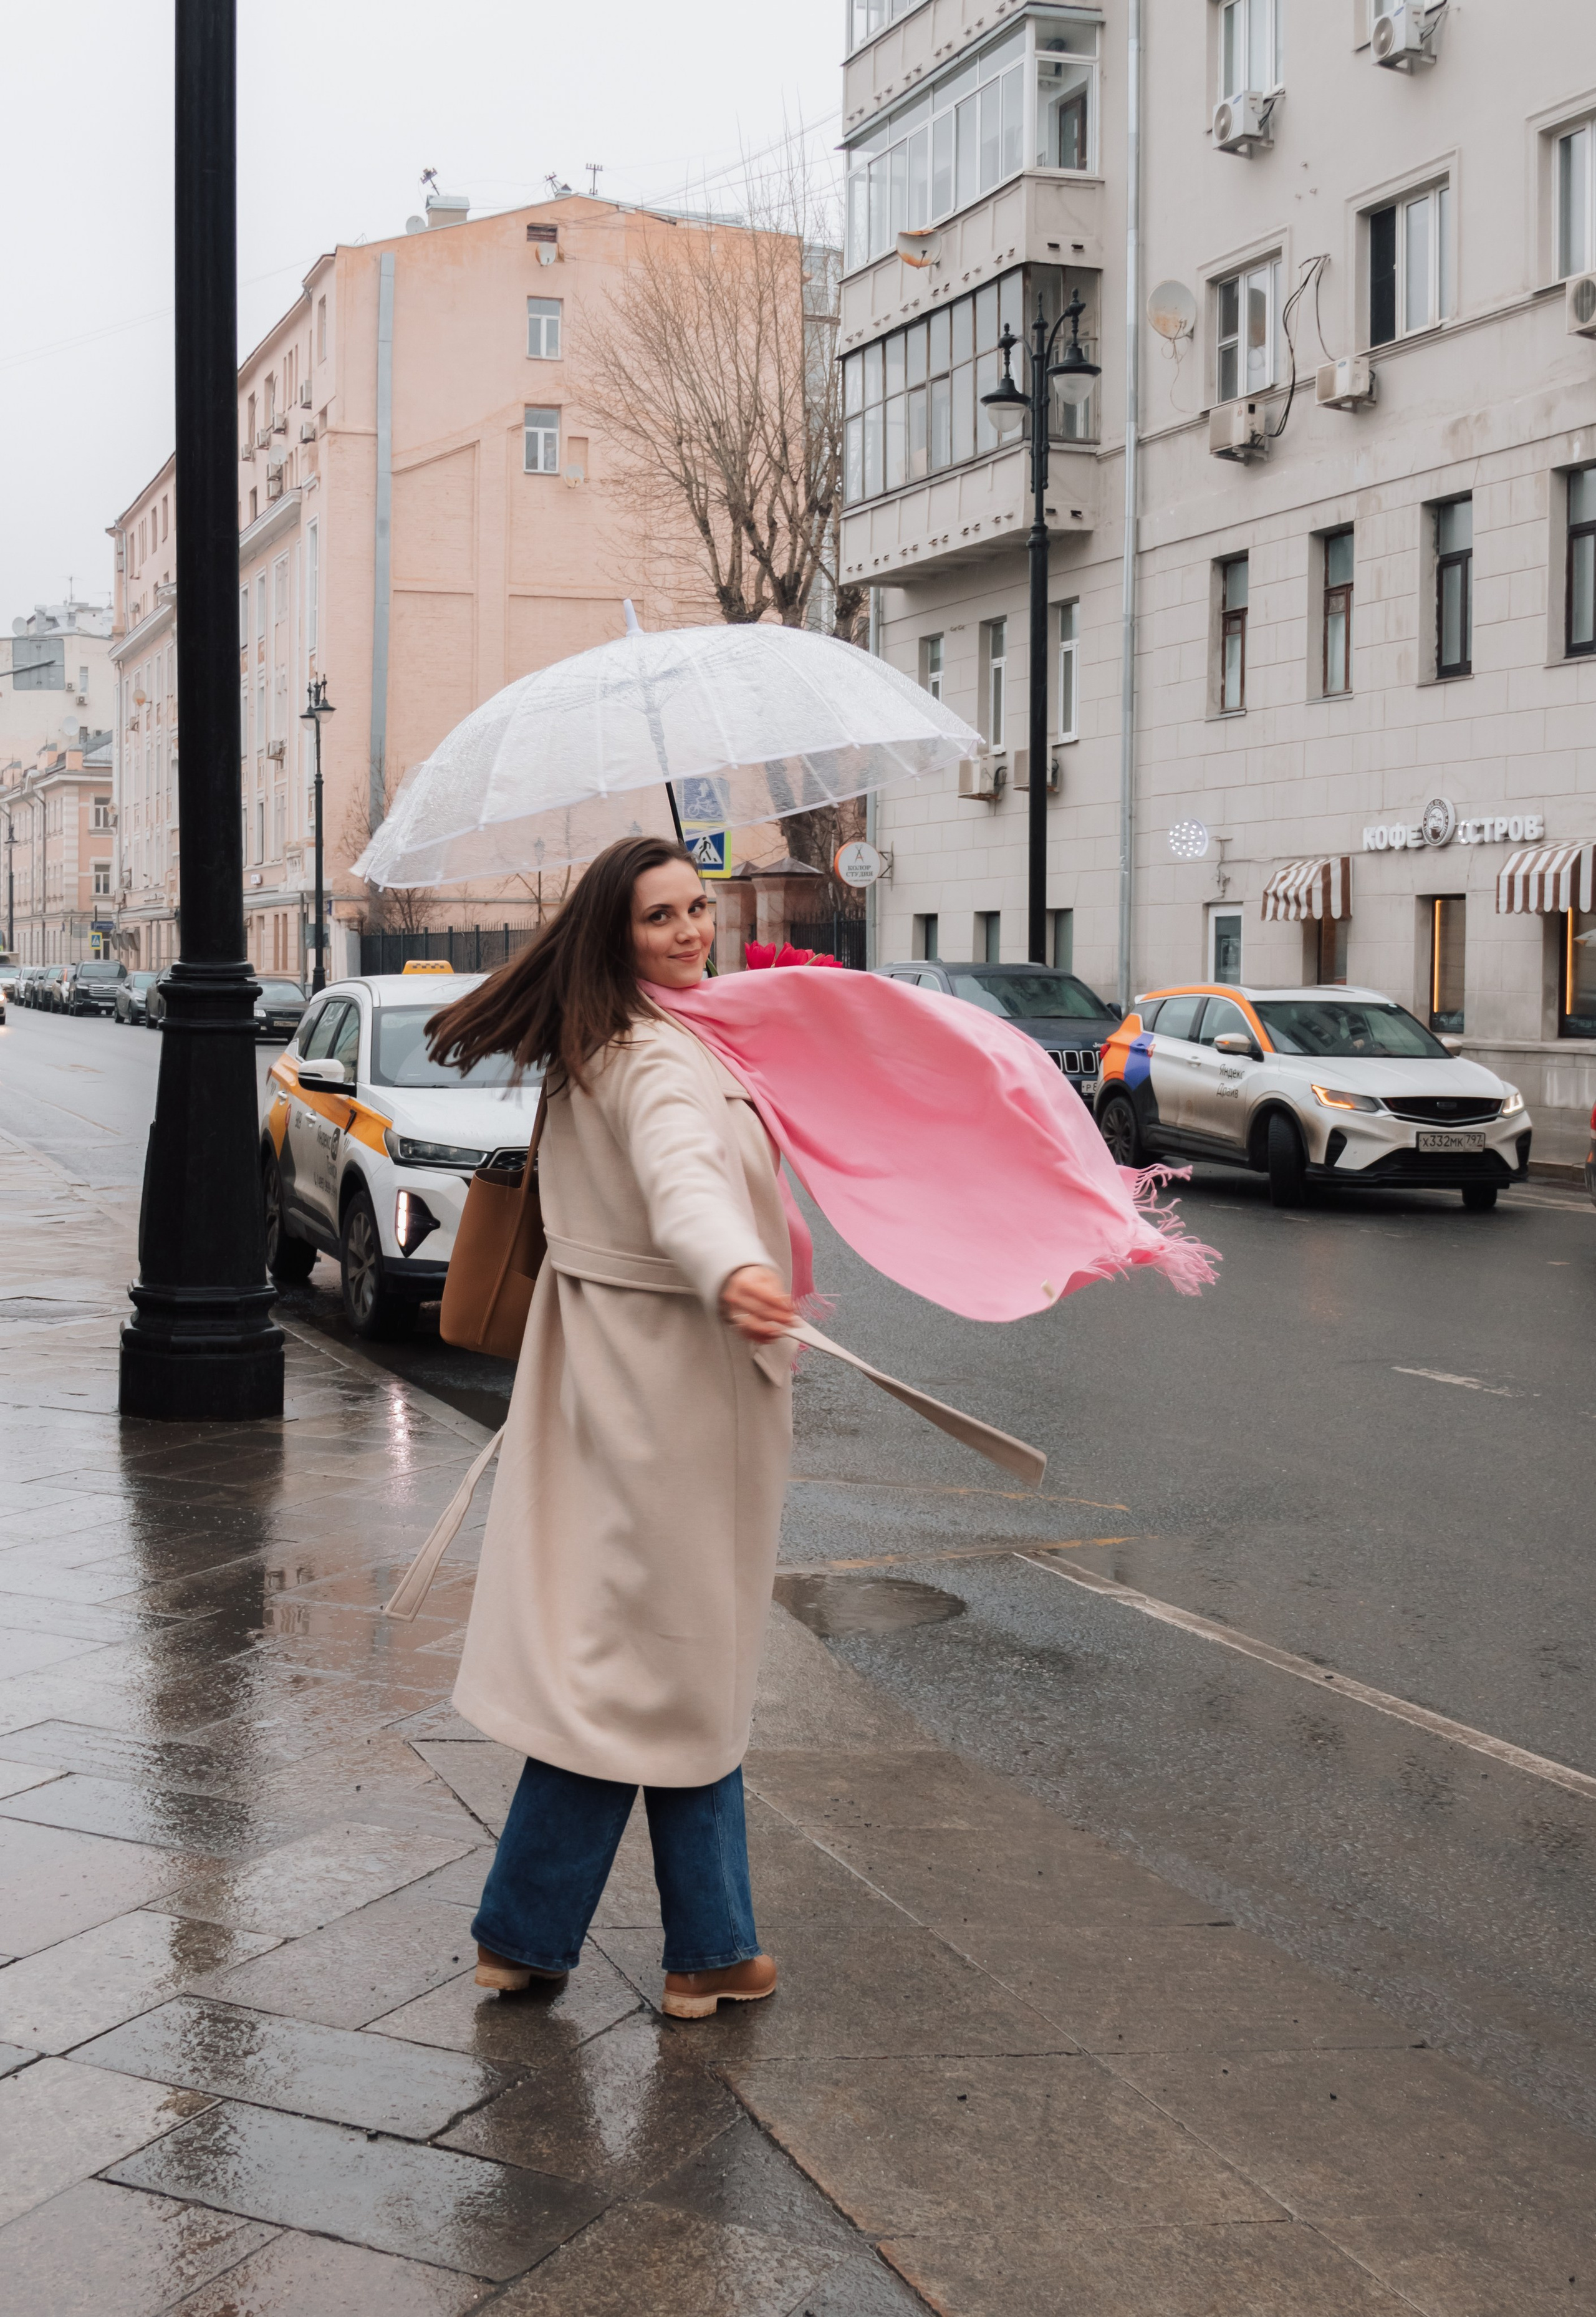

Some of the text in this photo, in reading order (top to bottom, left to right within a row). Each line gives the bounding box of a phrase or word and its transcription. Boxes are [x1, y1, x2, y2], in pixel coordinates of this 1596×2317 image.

[1363, 815, 1544, 851] КОФЕ ОСТРОВ
[1219, 1064, 1245, 1079] Яндекс
[1216, 1082, 1239, 1099] Драйв
[1423, 1135, 1463, 1147] Х332МК
[1466, 1135, 1483, 1145] 797
